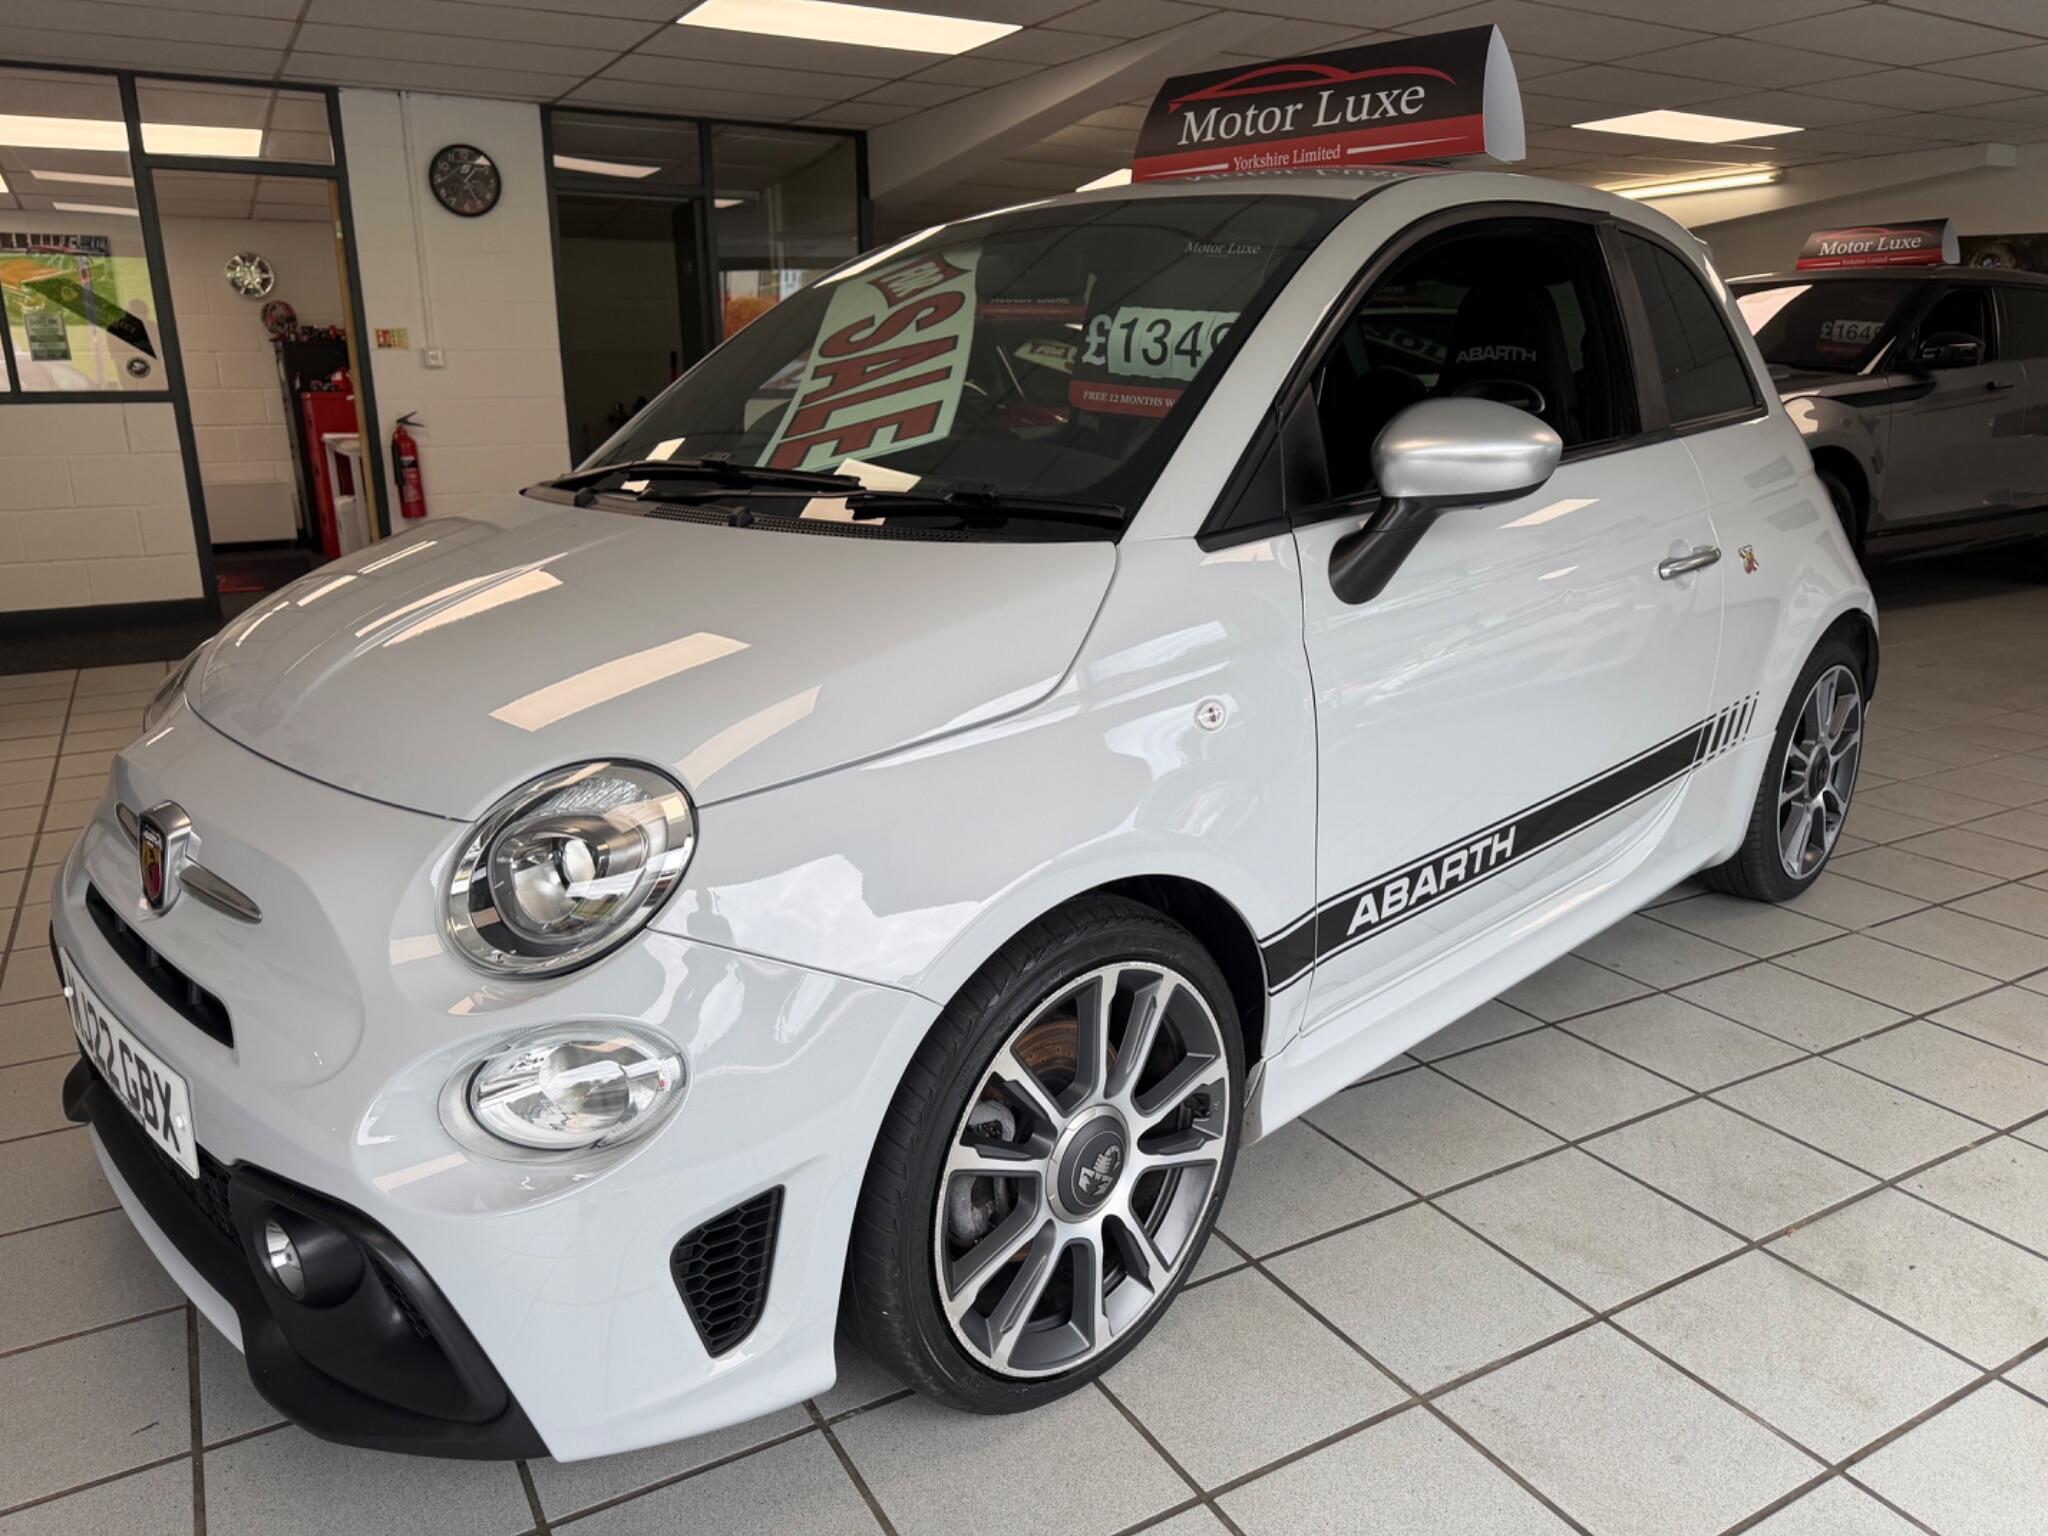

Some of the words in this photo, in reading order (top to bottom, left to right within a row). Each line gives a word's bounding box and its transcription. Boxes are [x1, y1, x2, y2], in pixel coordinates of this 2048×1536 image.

[1177, 101, 1303, 146] Motor
[1312, 84, 1426, 128] Luxe
[1233, 151, 1290, 171] Yorkshire
[1293, 144, 1341, 164] Limited
[1184, 241, 1225, 255] Motor
[1819, 239, 1873, 257] Motor
[1877, 235, 1923, 251] Luxe
[1455, 345, 1537, 364] ABARTH
[765, 291, 967, 470] SALE
[1083, 391, 1106, 401] FREE
[1110, 393, 1119, 402] 12
[1120, 394, 1163, 406] MONTHS
[1346, 826, 1517, 936] ABARTH
[118, 1038, 181, 1153] GBX
